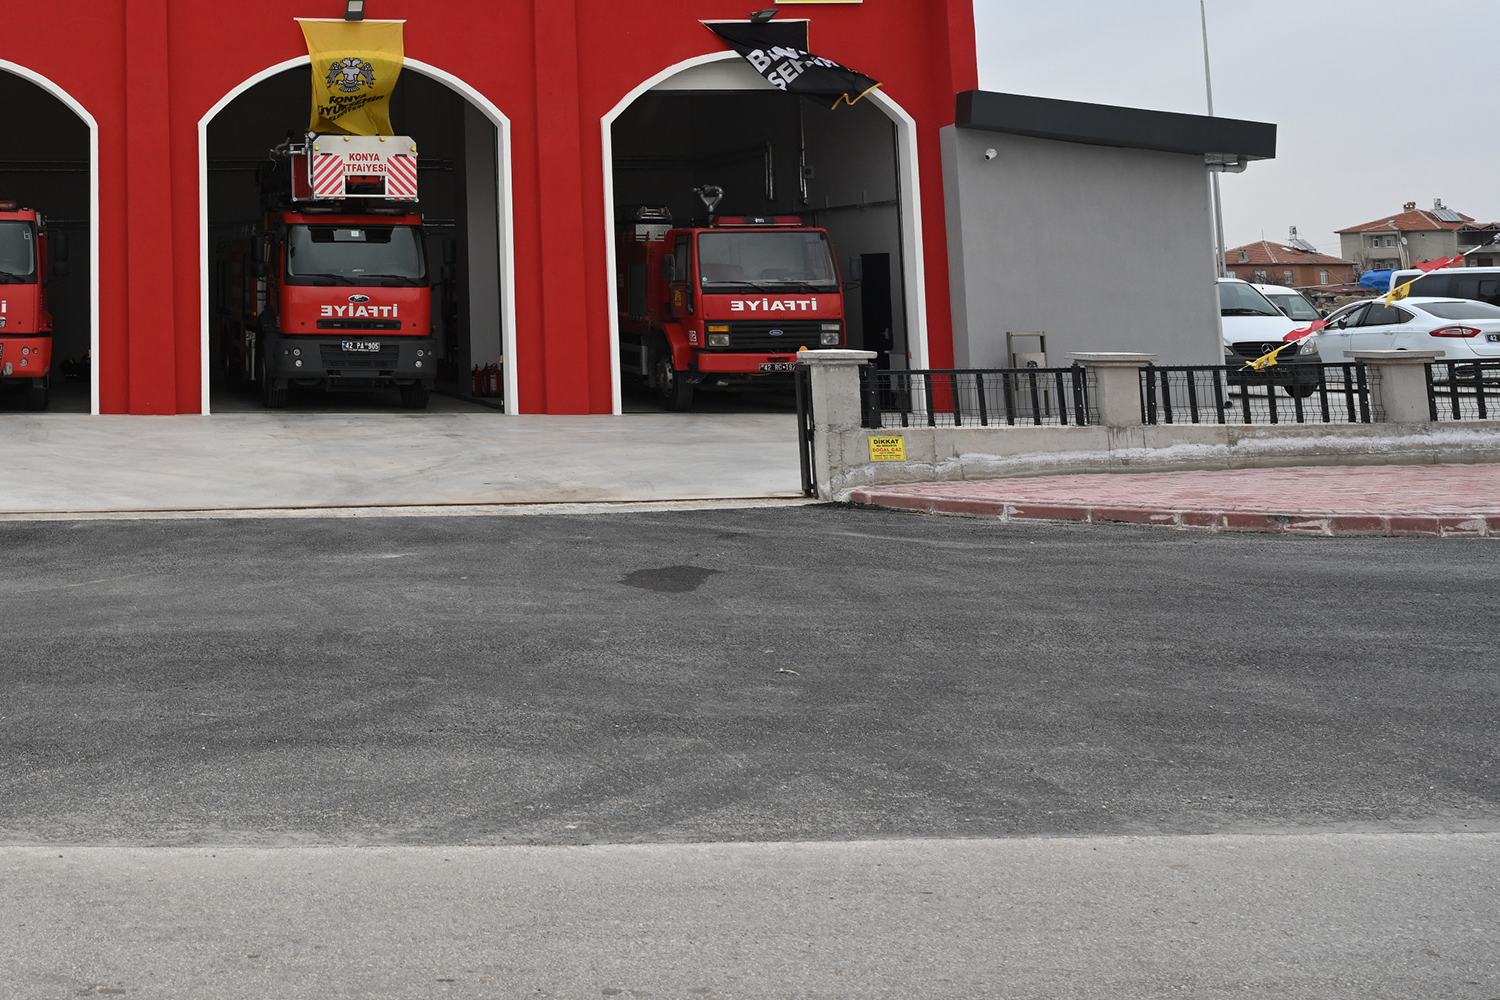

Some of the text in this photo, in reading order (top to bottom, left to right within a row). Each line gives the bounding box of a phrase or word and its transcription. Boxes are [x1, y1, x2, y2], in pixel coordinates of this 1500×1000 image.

[329, 94, 366, 104] KONYA
[349, 153, 380, 161] KONYA
[343, 164, 387, 172] İTFAİYESİ
